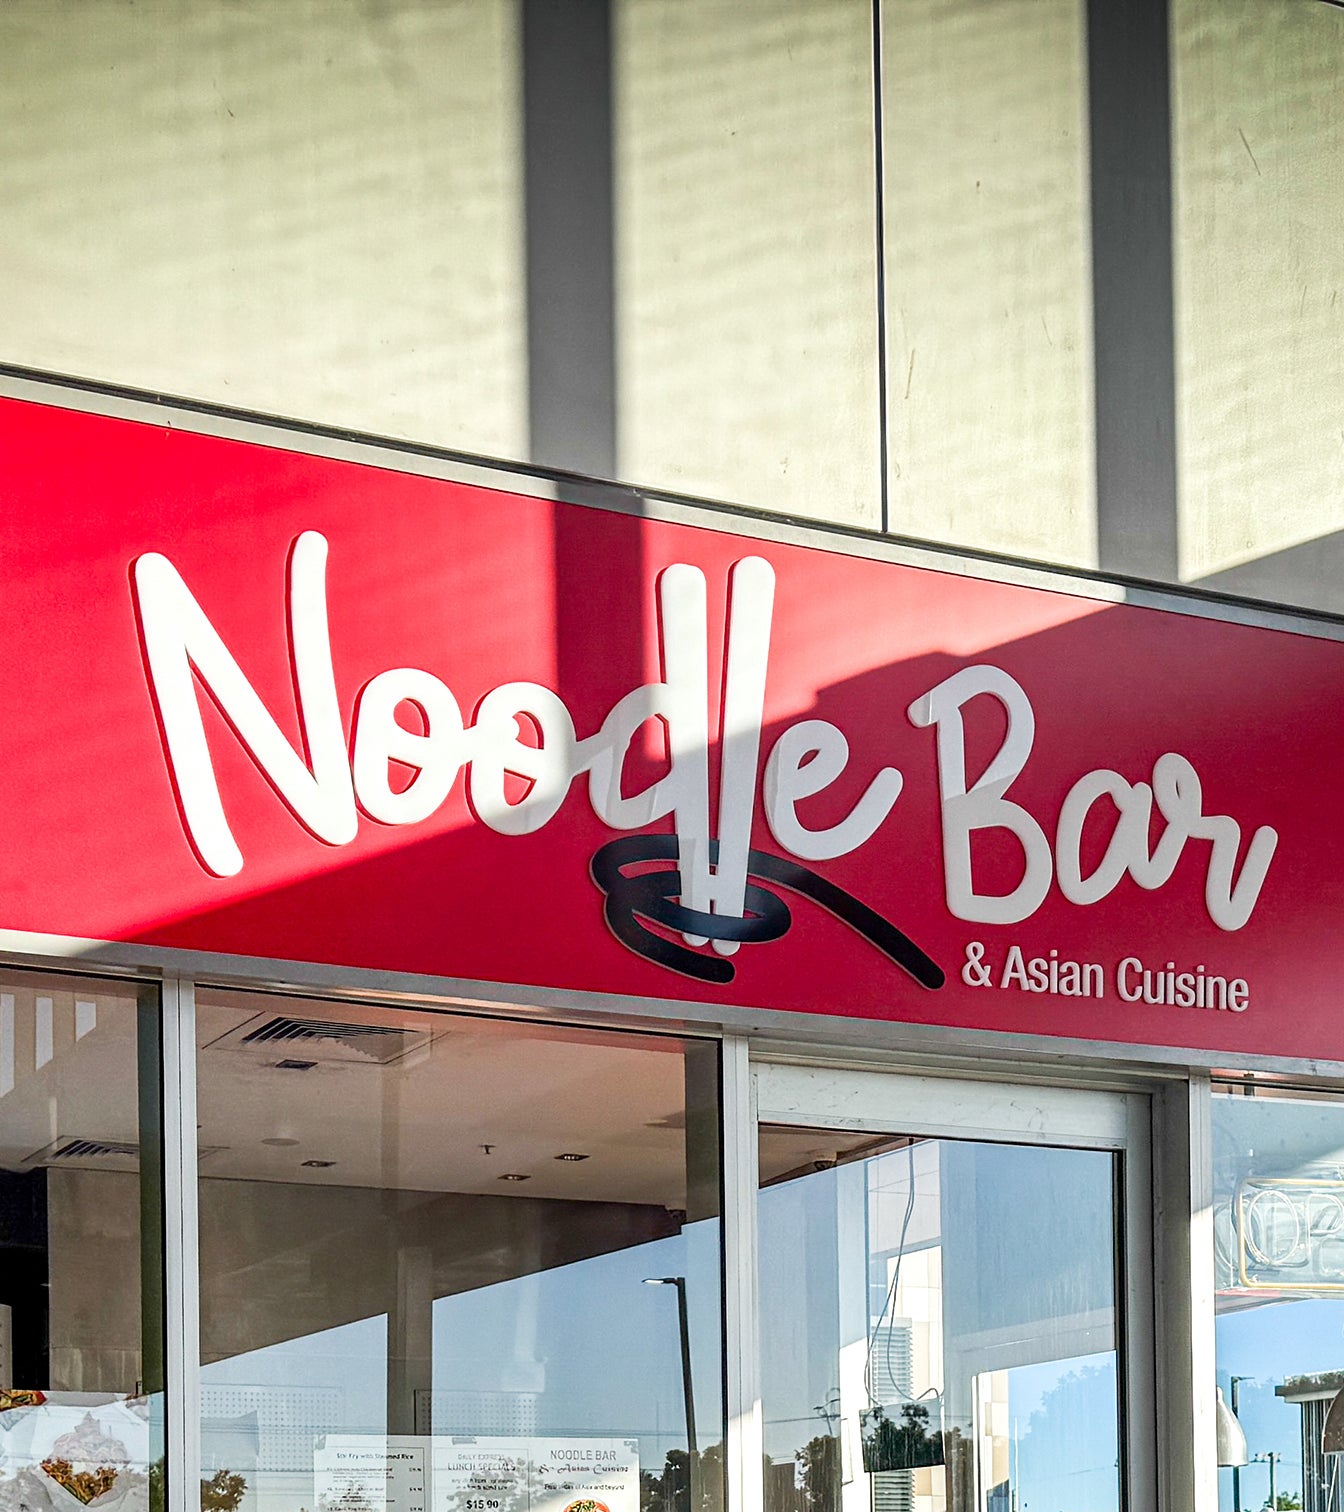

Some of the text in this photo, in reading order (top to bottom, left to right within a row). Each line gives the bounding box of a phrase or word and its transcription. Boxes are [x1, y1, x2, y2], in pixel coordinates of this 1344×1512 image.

[130, 530, 1278, 957] Noodle Bar
[961, 940, 1250, 1013] & Asian Cuisine
[550, 1449, 617, 1461] NOODLE BAR
